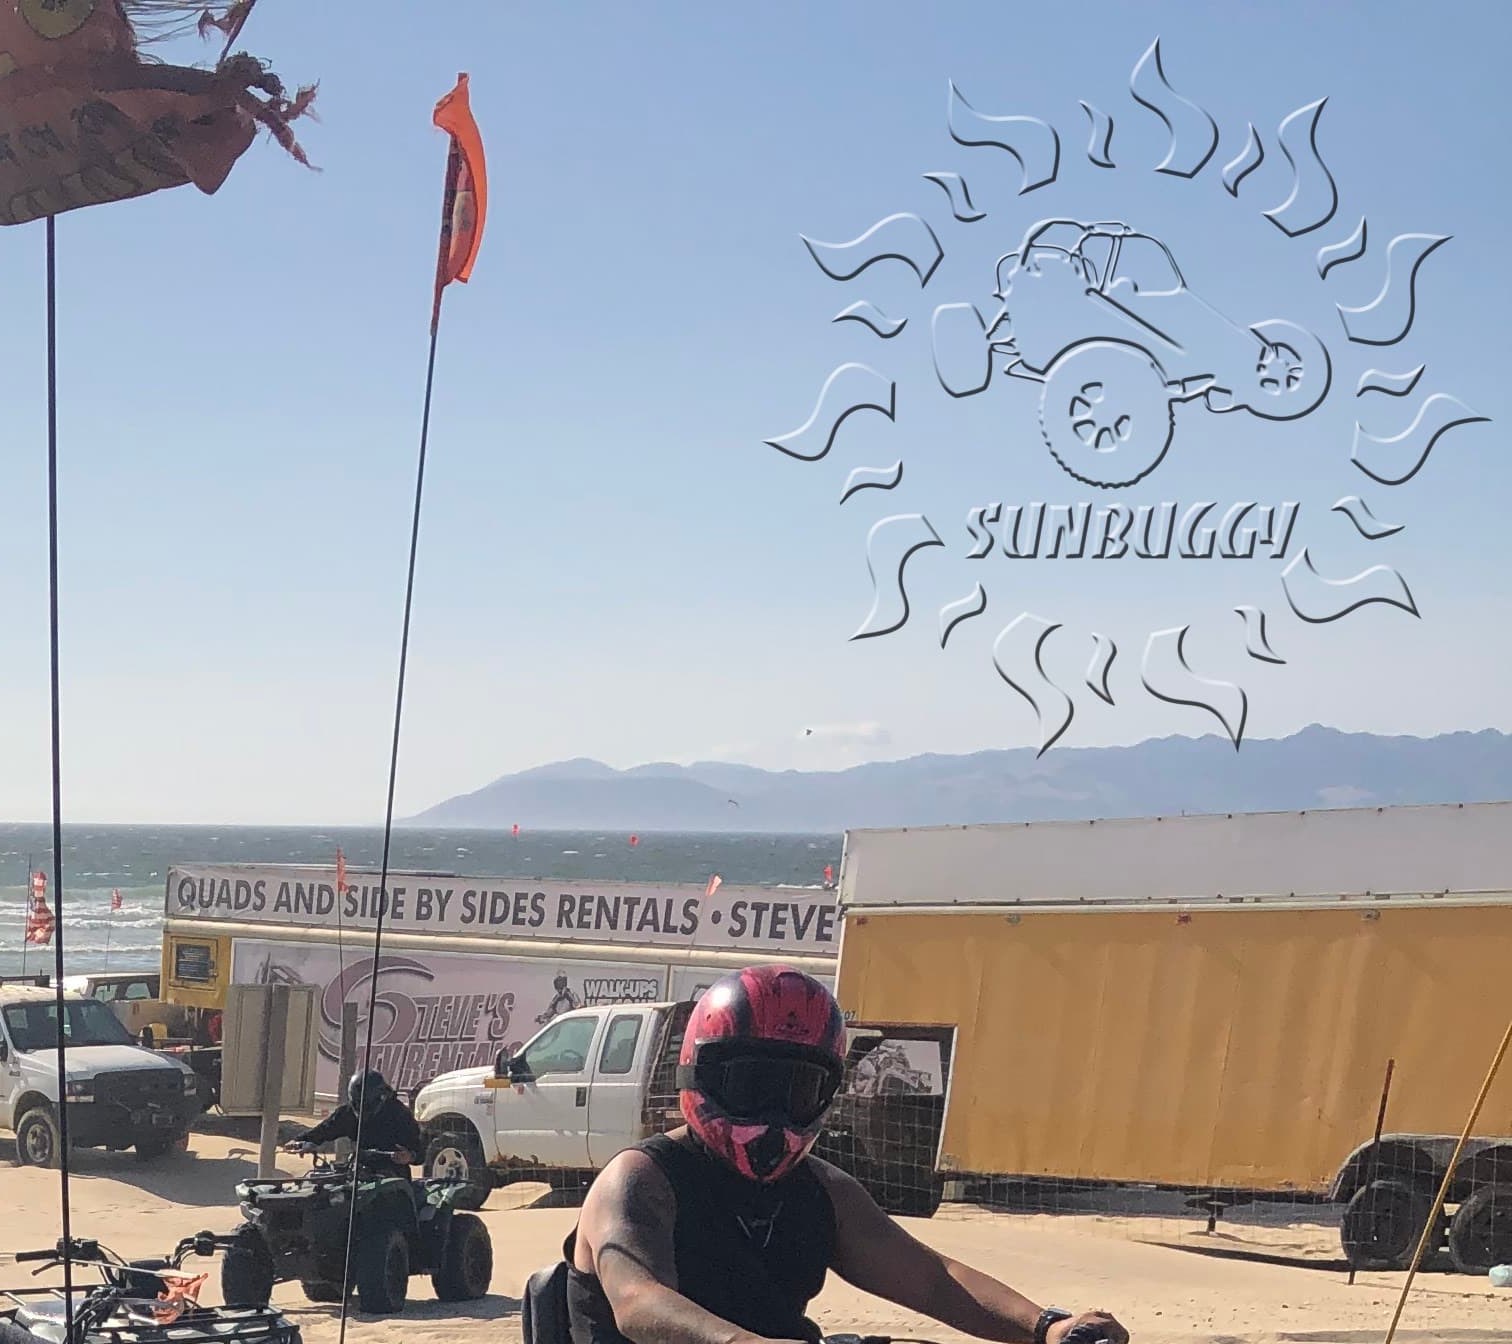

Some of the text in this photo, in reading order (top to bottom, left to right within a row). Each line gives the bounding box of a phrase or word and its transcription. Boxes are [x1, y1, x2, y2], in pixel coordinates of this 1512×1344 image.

[177, 877, 267, 912] QUADS
[273, 881, 335, 916] AND
[343, 884, 407, 920] SIDE
[415, 886, 454, 922] BY
[460, 890, 546, 927] SIDES
[556, 893, 700, 936] RENTALS
[583, 978, 658, 1000] WALK-UPS
